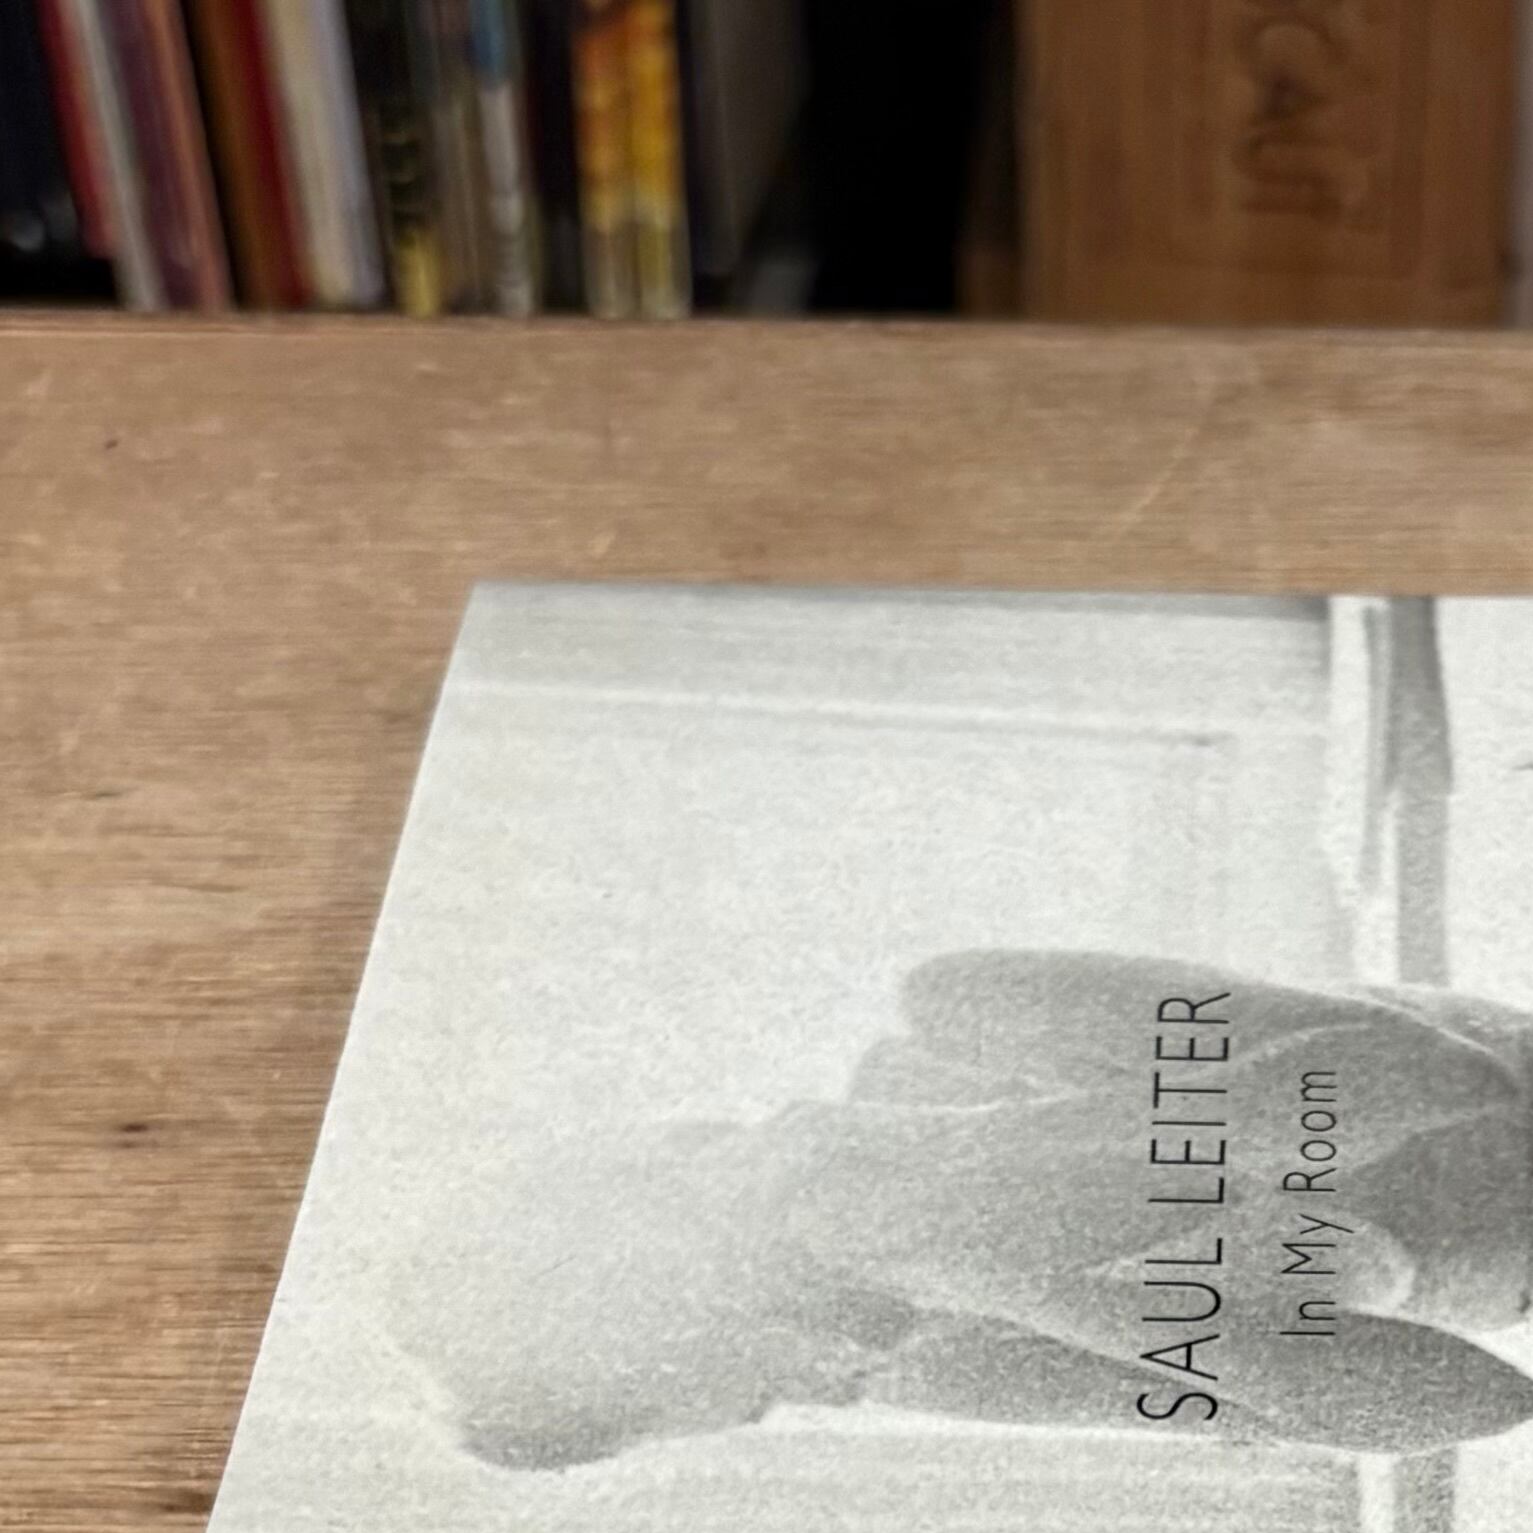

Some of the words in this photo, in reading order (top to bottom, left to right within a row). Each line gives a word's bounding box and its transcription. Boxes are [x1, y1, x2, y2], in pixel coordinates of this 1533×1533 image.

[1148, 992, 1231, 1204] LEITER
[1282, 1071, 1337, 1191] Room
[1280, 1214, 1354, 1275] My
[1136, 1238, 1222, 1420] SAUL
[1280, 1301, 1336, 1336] In
